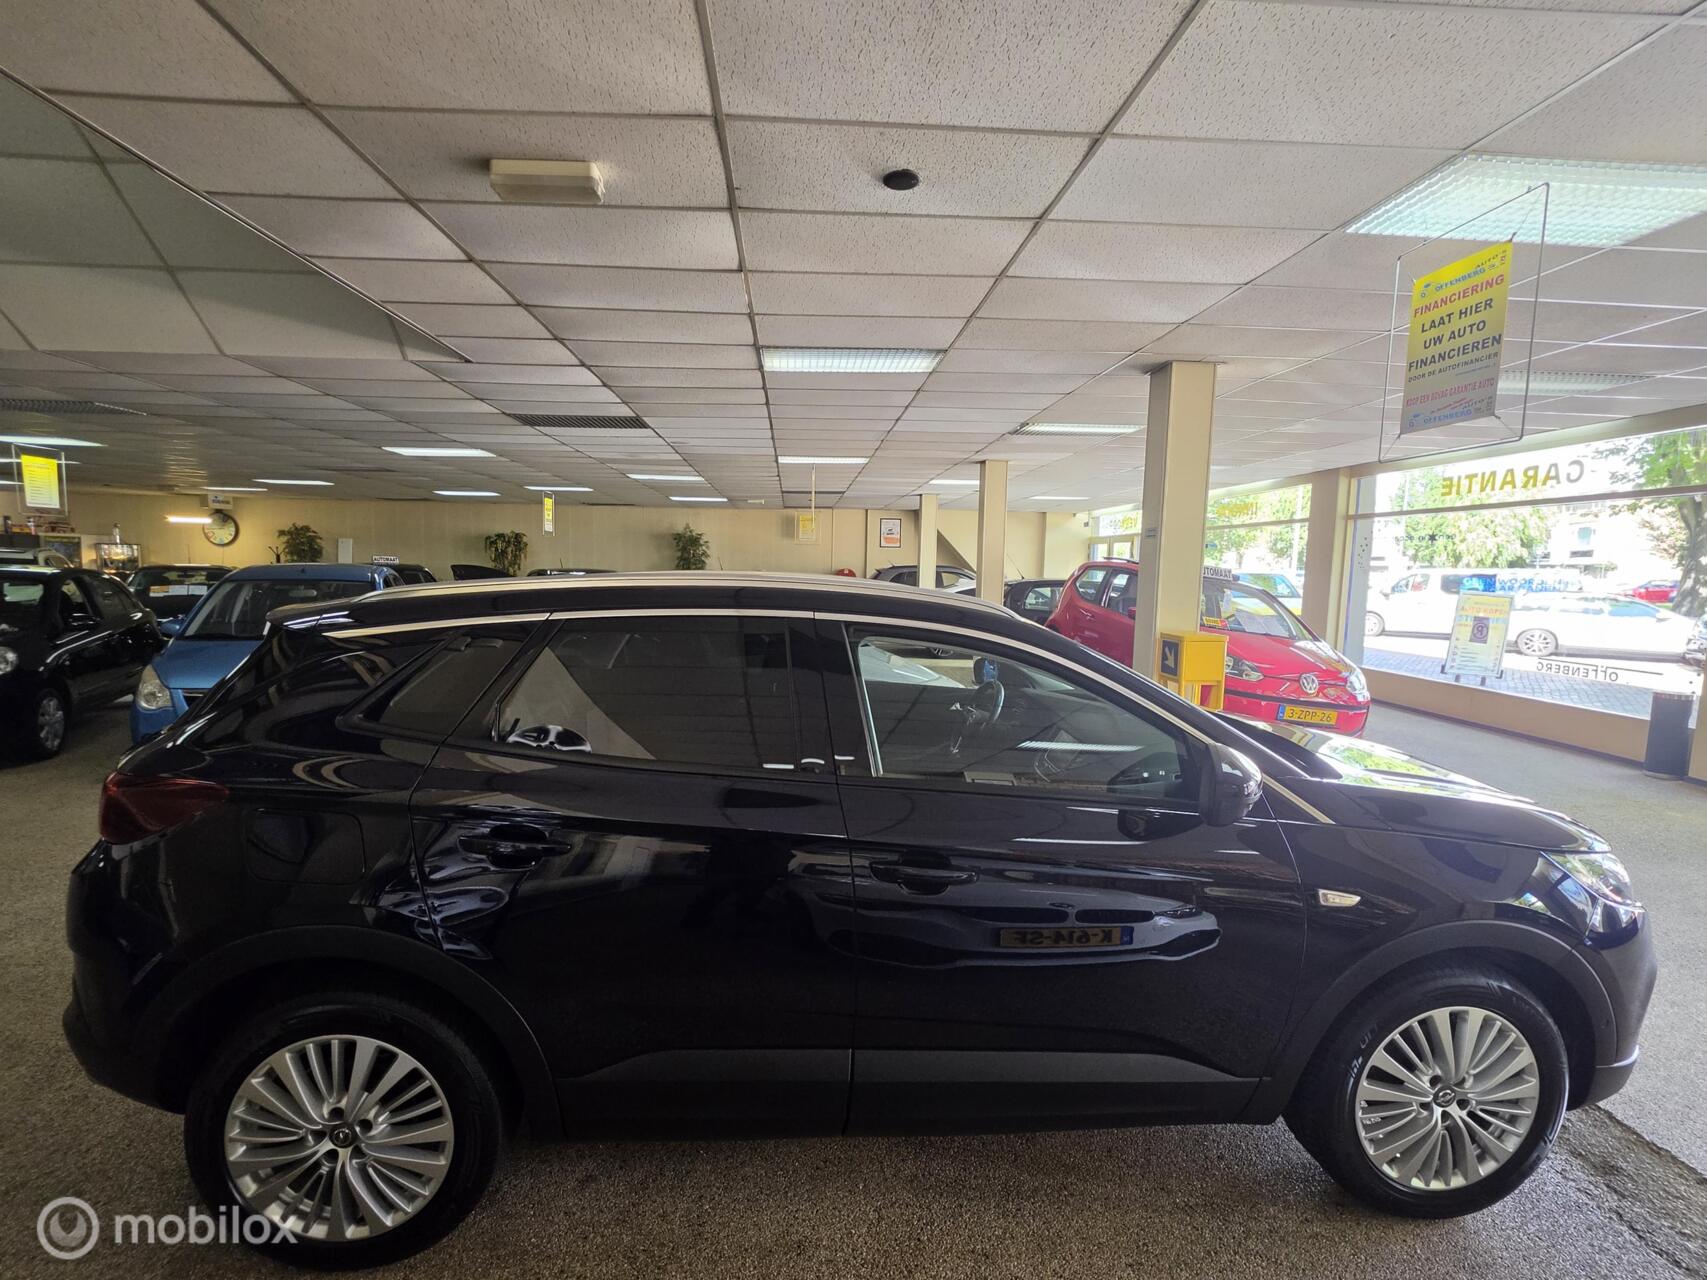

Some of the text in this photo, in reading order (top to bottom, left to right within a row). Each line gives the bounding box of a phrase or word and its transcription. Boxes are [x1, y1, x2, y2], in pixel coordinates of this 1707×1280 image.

[1413, 273, 1505, 318] FINANCIERING
[1434, 267, 1487, 293] OFFENBERG
[1421, 298, 1494, 334] LAAT HIER
[1423, 319, 1487, 350] UW AUTO
[1408, 333, 1502, 372] FINANCIEREN
[1408, 373, 1426, 383] DOOR
[1427, 369, 1436, 377] DE
[1438, 351, 1499, 374] AUTOFINANCIER
[1449, 381, 1479, 398] GARANTIE
[1478, 377, 1495, 389] AUTO
[1287, 708, 1333, 723] 3-ZPP-26
